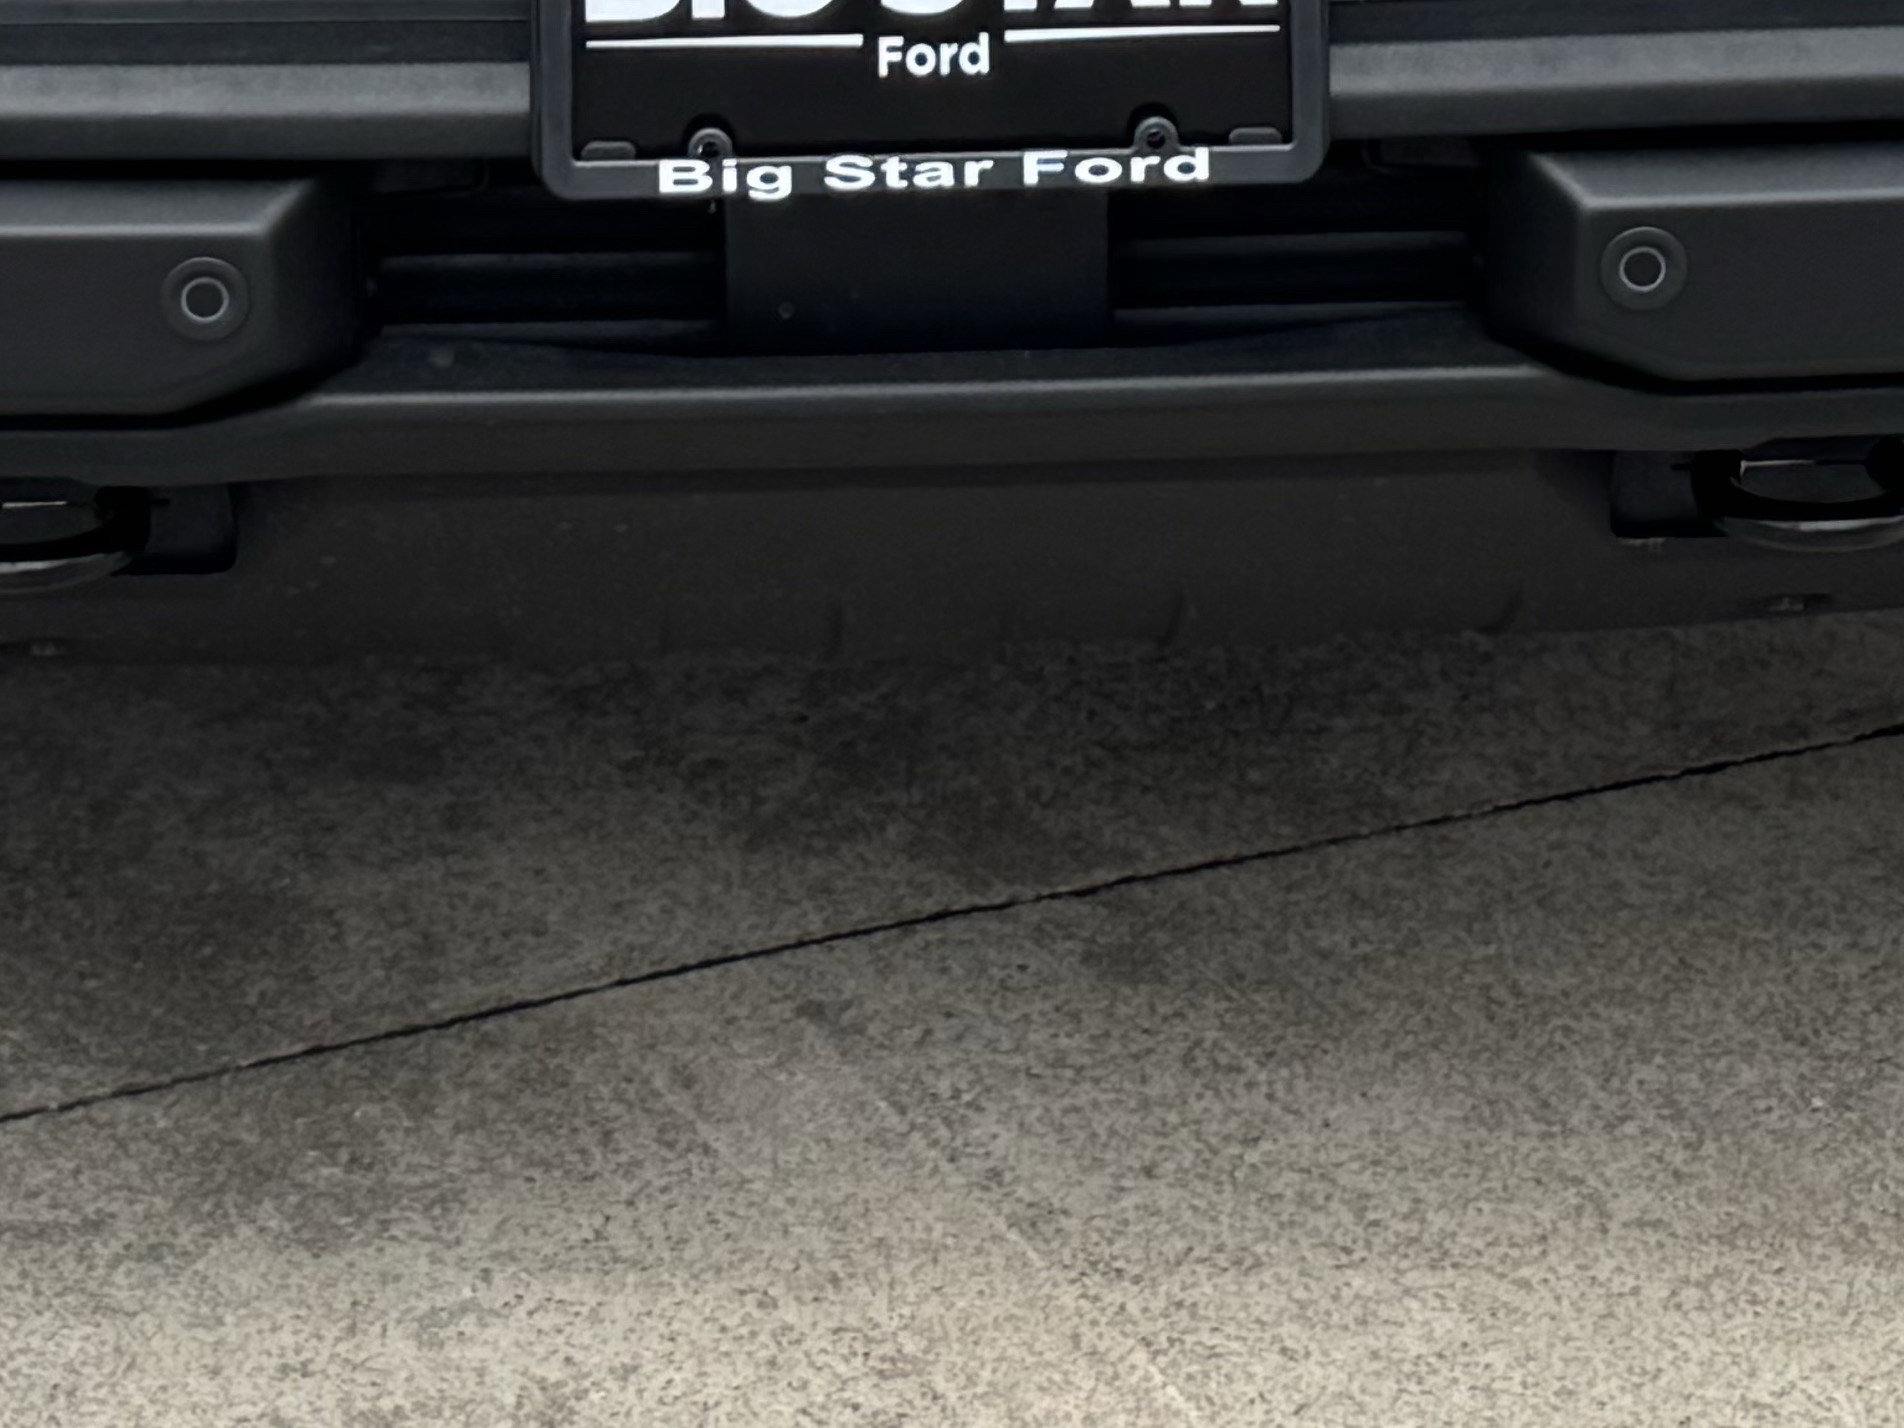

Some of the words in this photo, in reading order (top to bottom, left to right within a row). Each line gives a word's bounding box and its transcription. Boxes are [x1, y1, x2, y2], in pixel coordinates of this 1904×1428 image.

[877, 30, 991, 78] Ford
[658, 157, 794, 201] Big
[823, 153, 994, 191] Star
[1022, 146, 1210, 186] Ford
